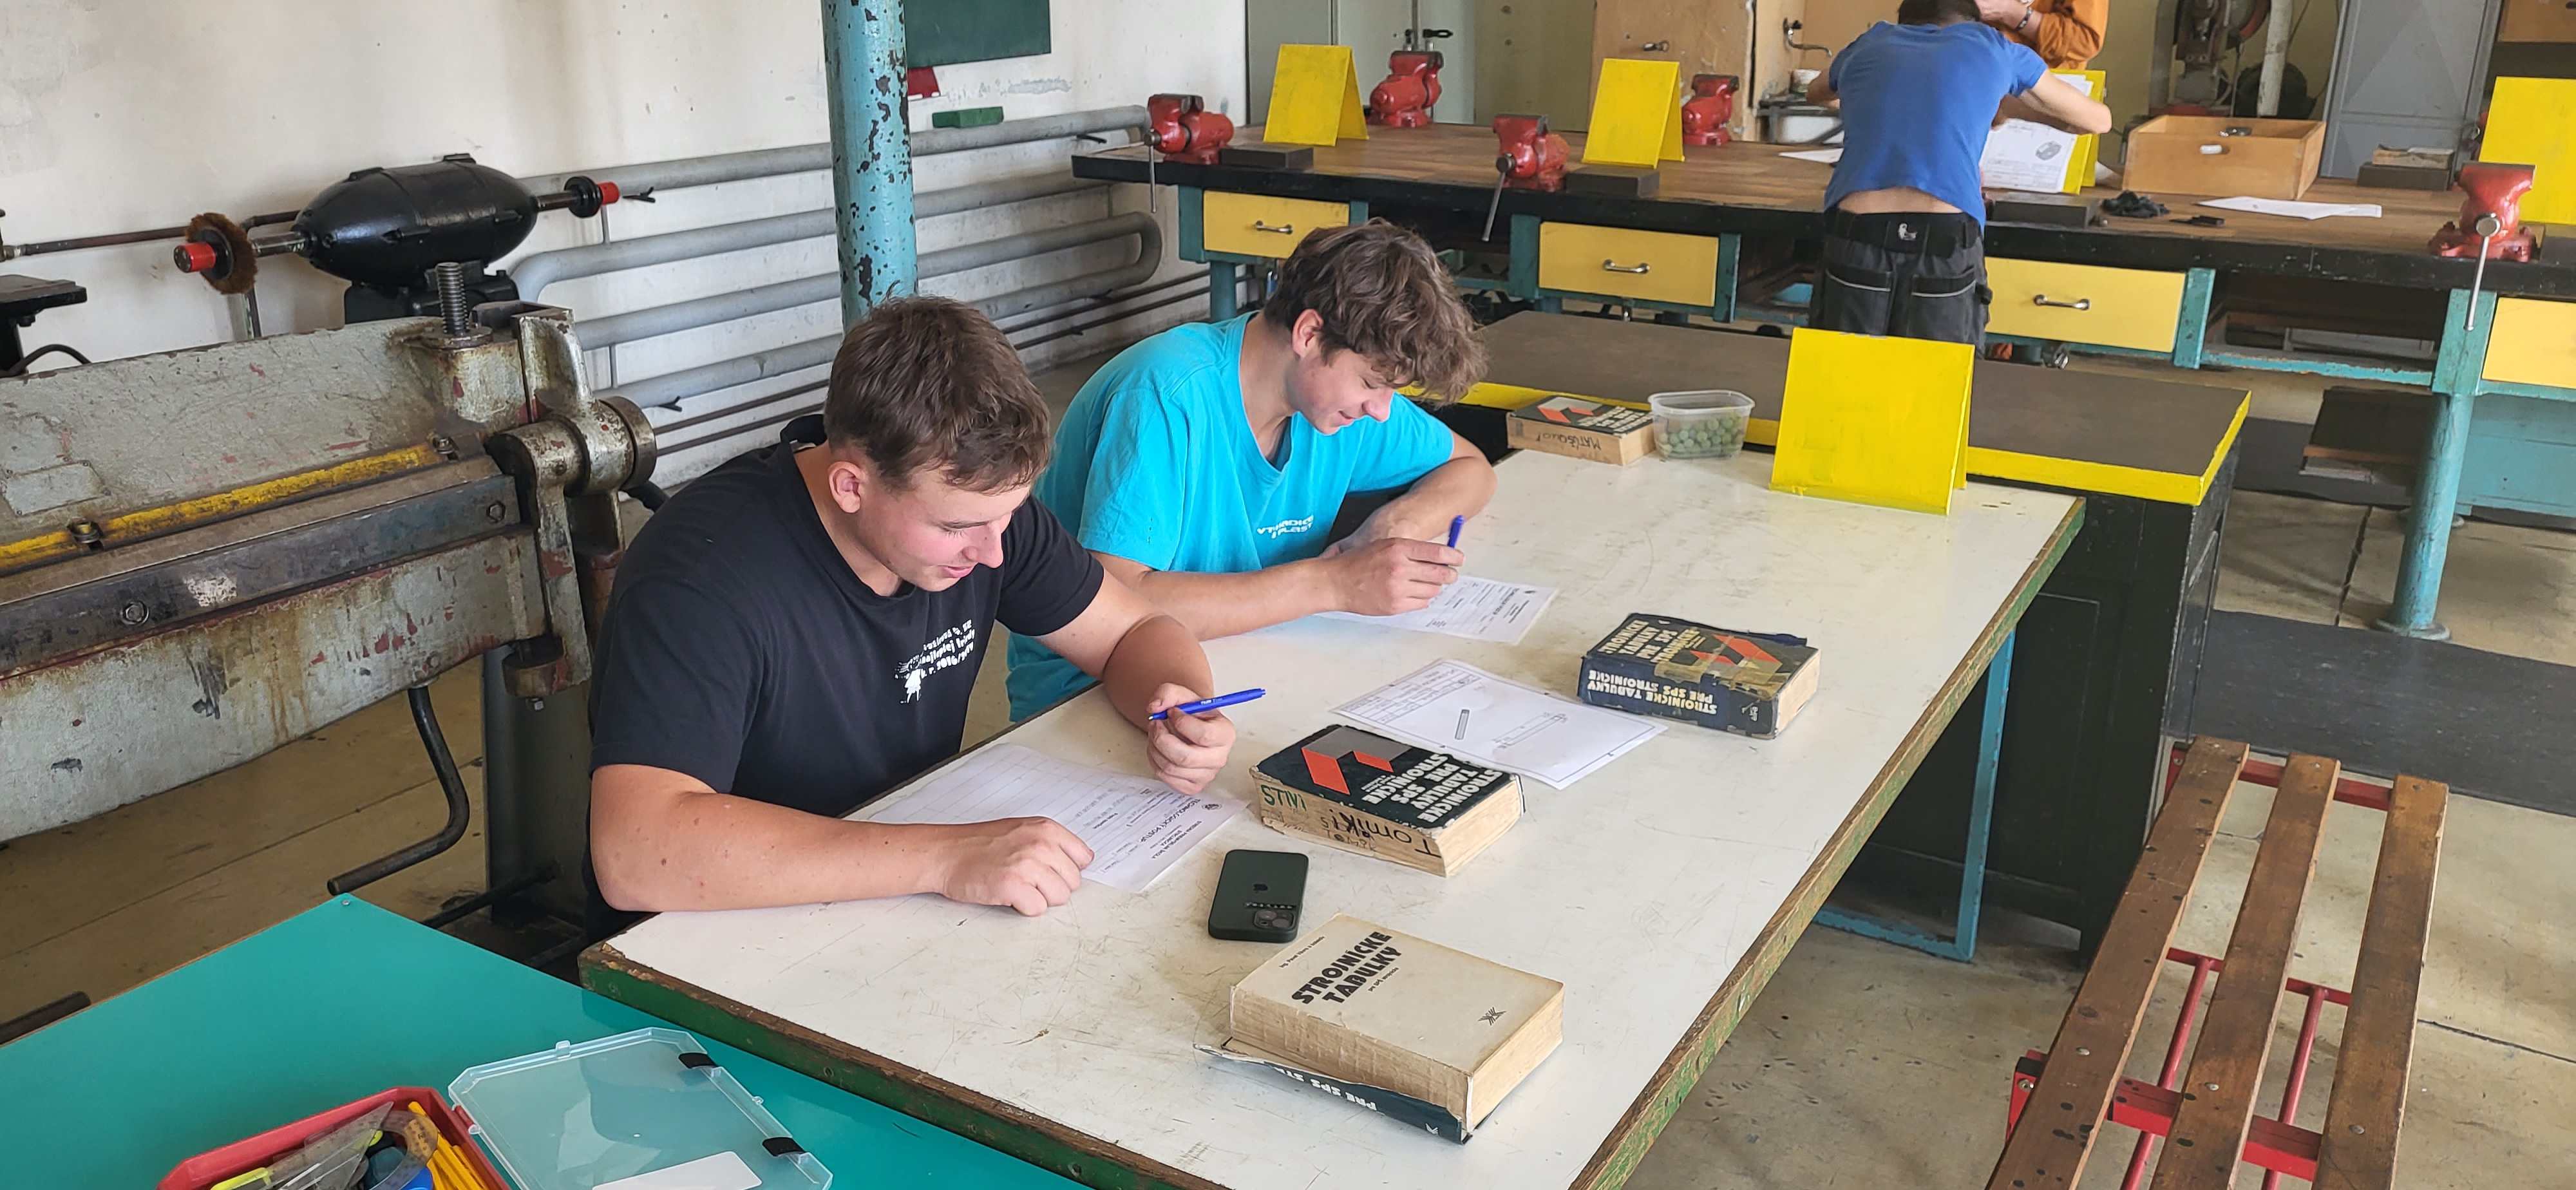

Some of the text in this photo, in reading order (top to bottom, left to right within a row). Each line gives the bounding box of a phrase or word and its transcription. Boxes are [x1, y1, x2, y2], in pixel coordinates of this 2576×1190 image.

[1689, 690, 1713, 704] PRE
[1424, 763, 1461, 782] PRE
[1345, 1091, 1377, 1111] PRE
